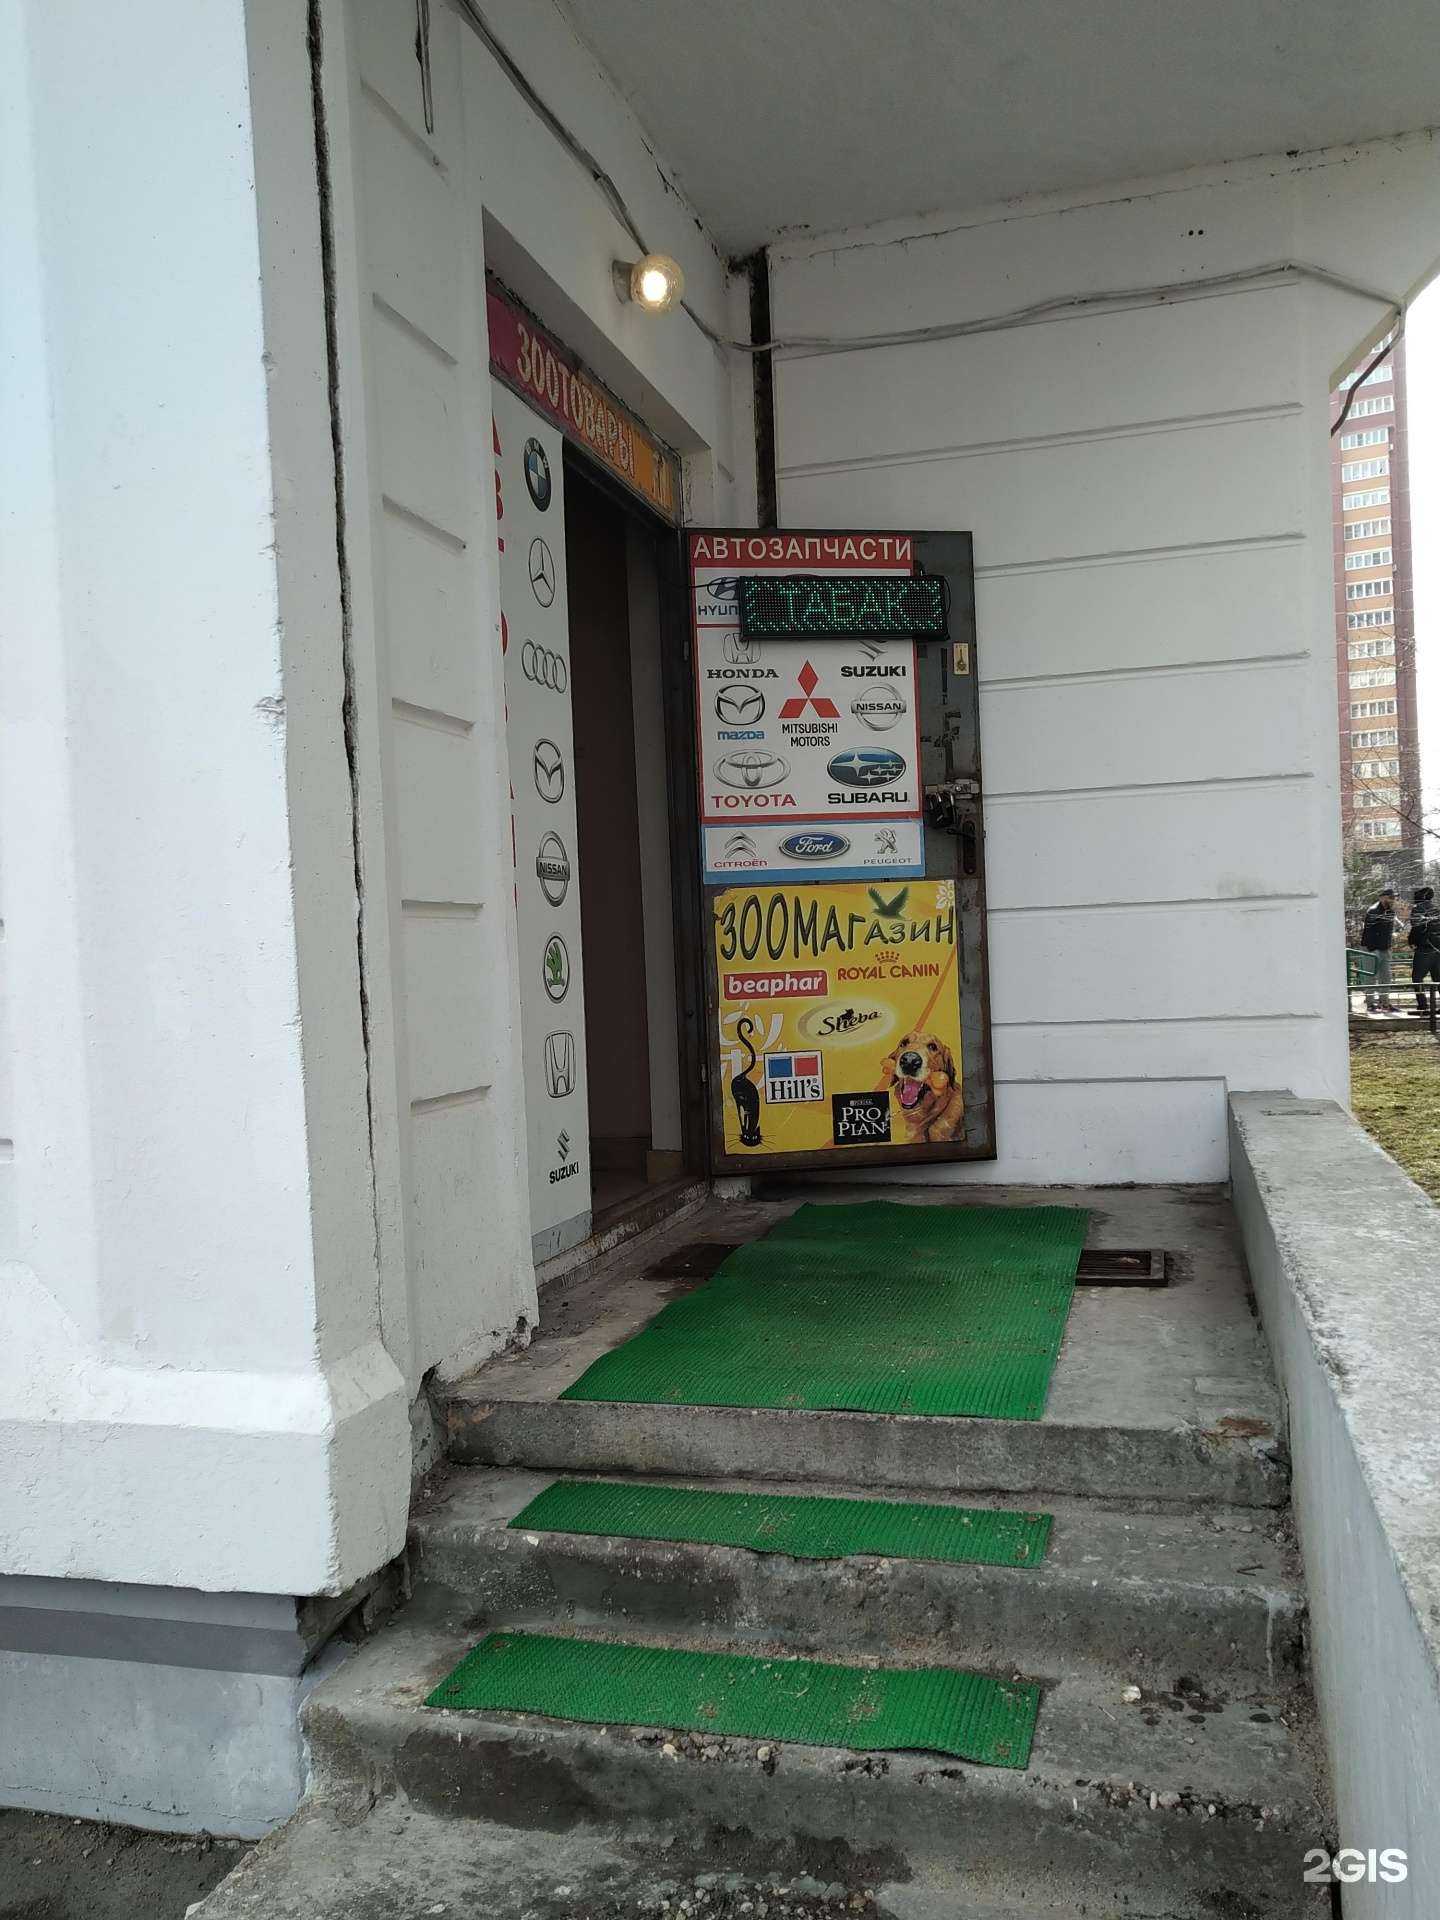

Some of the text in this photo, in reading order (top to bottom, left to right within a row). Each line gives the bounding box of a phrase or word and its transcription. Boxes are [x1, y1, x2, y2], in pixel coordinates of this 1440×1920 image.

[517, 322, 635, 479] ЗООТОВАРЫ
[693, 536, 911, 561] АВТОЗАПЧАСТИ
[698, 604, 739, 616] HYUN
[780, 585, 908, 628] ТАБАК
[706, 668, 780, 679] HONDA
[840, 665, 907, 678] SUZUKI
[856, 702, 902, 711] NISSAN
[782, 722, 838, 734] MITSUBISHI
[790, 736, 831, 747] MOTORS
[711, 794, 797, 808] TOYOTA
[827, 792, 908, 804] SUBARU
[795, 836, 833, 853] Ford
[540, 861, 567, 876] NISSAN
[837, 963, 940, 980] ROYAL CANIN
[728, 974, 823, 998] beaphar
[818, 1008, 882, 1035] Sheba
[769, 1078, 821, 1101] Hill's
[842, 1107, 881, 1122] PRO
[838, 1121, 885, 1137] PLAN
[549, 1161, 579, 1184] SUZUKI
